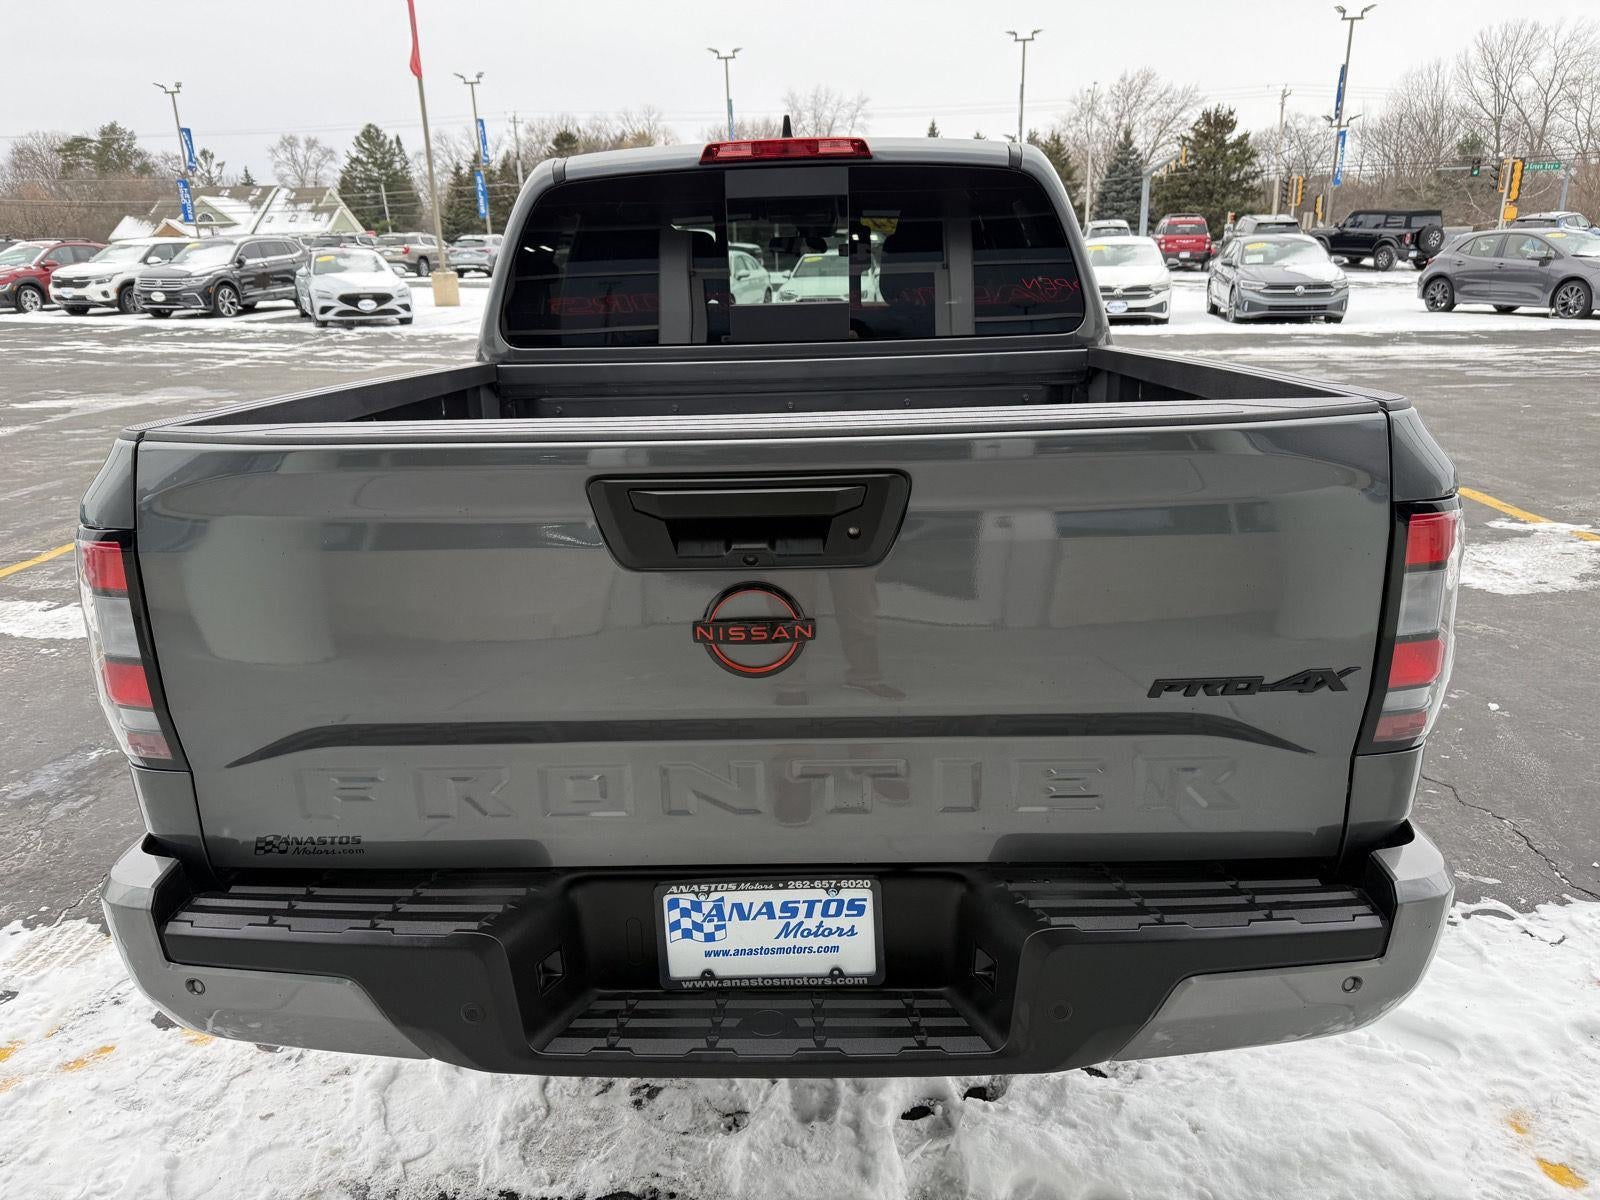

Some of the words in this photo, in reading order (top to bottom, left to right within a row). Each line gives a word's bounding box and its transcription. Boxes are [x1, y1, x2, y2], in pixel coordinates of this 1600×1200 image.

[696, 624, 813, 641] NISSAN
[1147, 666, 1362, 699] PRO-4X
[297, 754, 1241, 821] FRONTIER
[278, 834, 362, 846] ANASTOS
[291, 845, 365, 856] Motors.com
[667, 883, 737, 894] ANASTOS
[737, 882, 775, 891] Motors
[787, 880, 872, 889] 262-657-6020
[701, 896, 868, 923] ANASTOS
[774, 920, 860, 940] Motors
[704, 944, 840, 958] www.anastosmotors.com
[681, 975, 868, 989] www.anastosmotors.com
